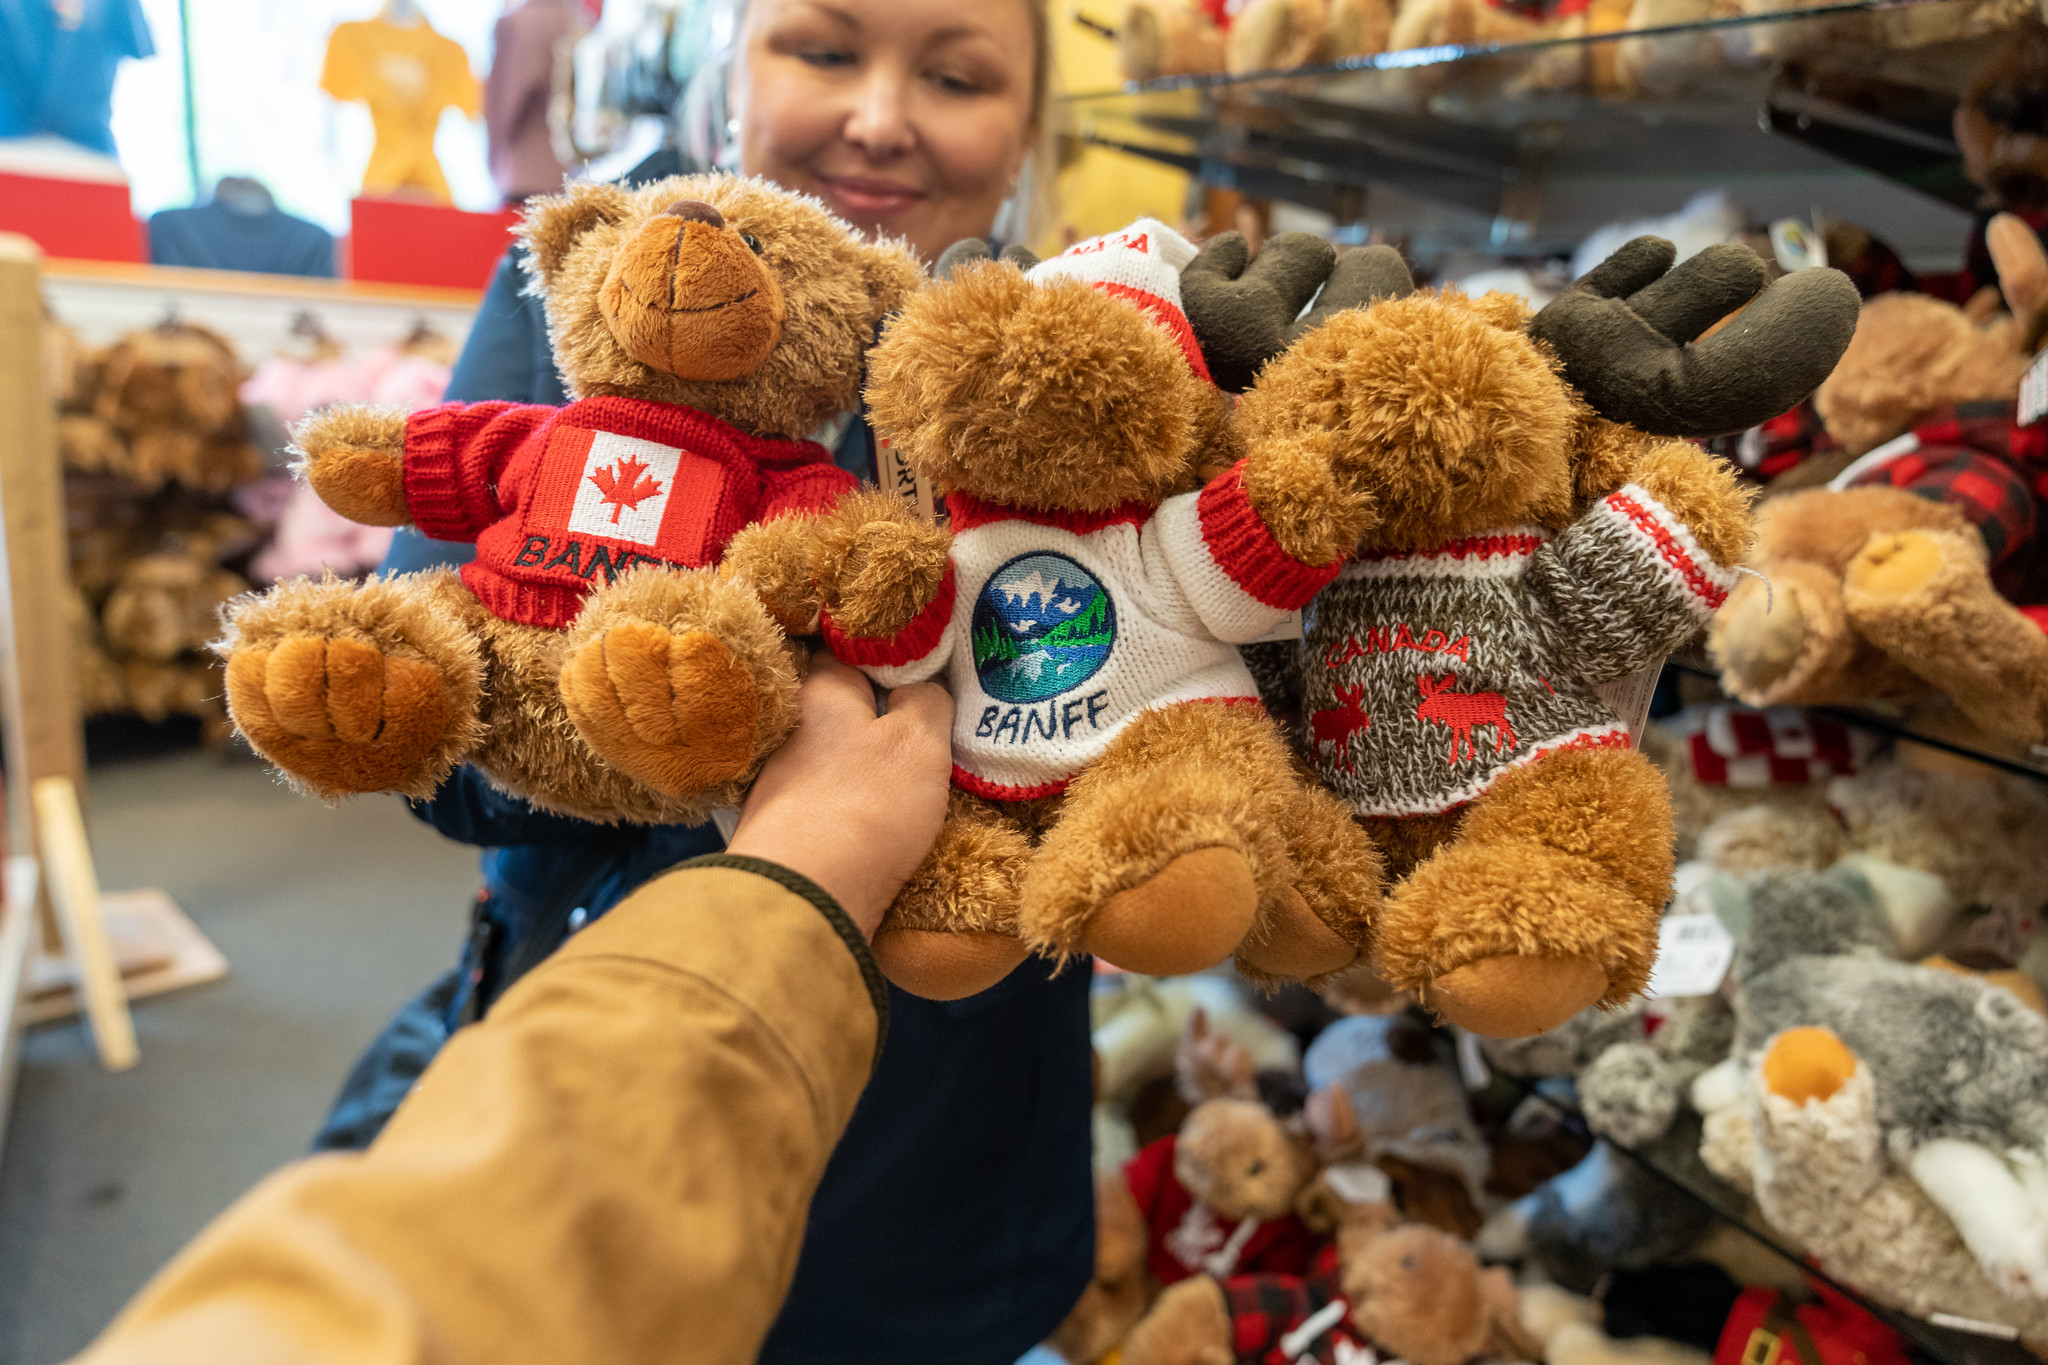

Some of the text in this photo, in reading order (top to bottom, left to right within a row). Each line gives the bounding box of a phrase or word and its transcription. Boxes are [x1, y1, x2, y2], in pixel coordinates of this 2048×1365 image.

[513, 536, 694, 587] BAN
[1326, 623, 1470, 669] CANADA
[975, 689, 1109, 744] BANFF
[1635, 703, 1644, 726] Made
[1645, 669, 1655, 692] China
